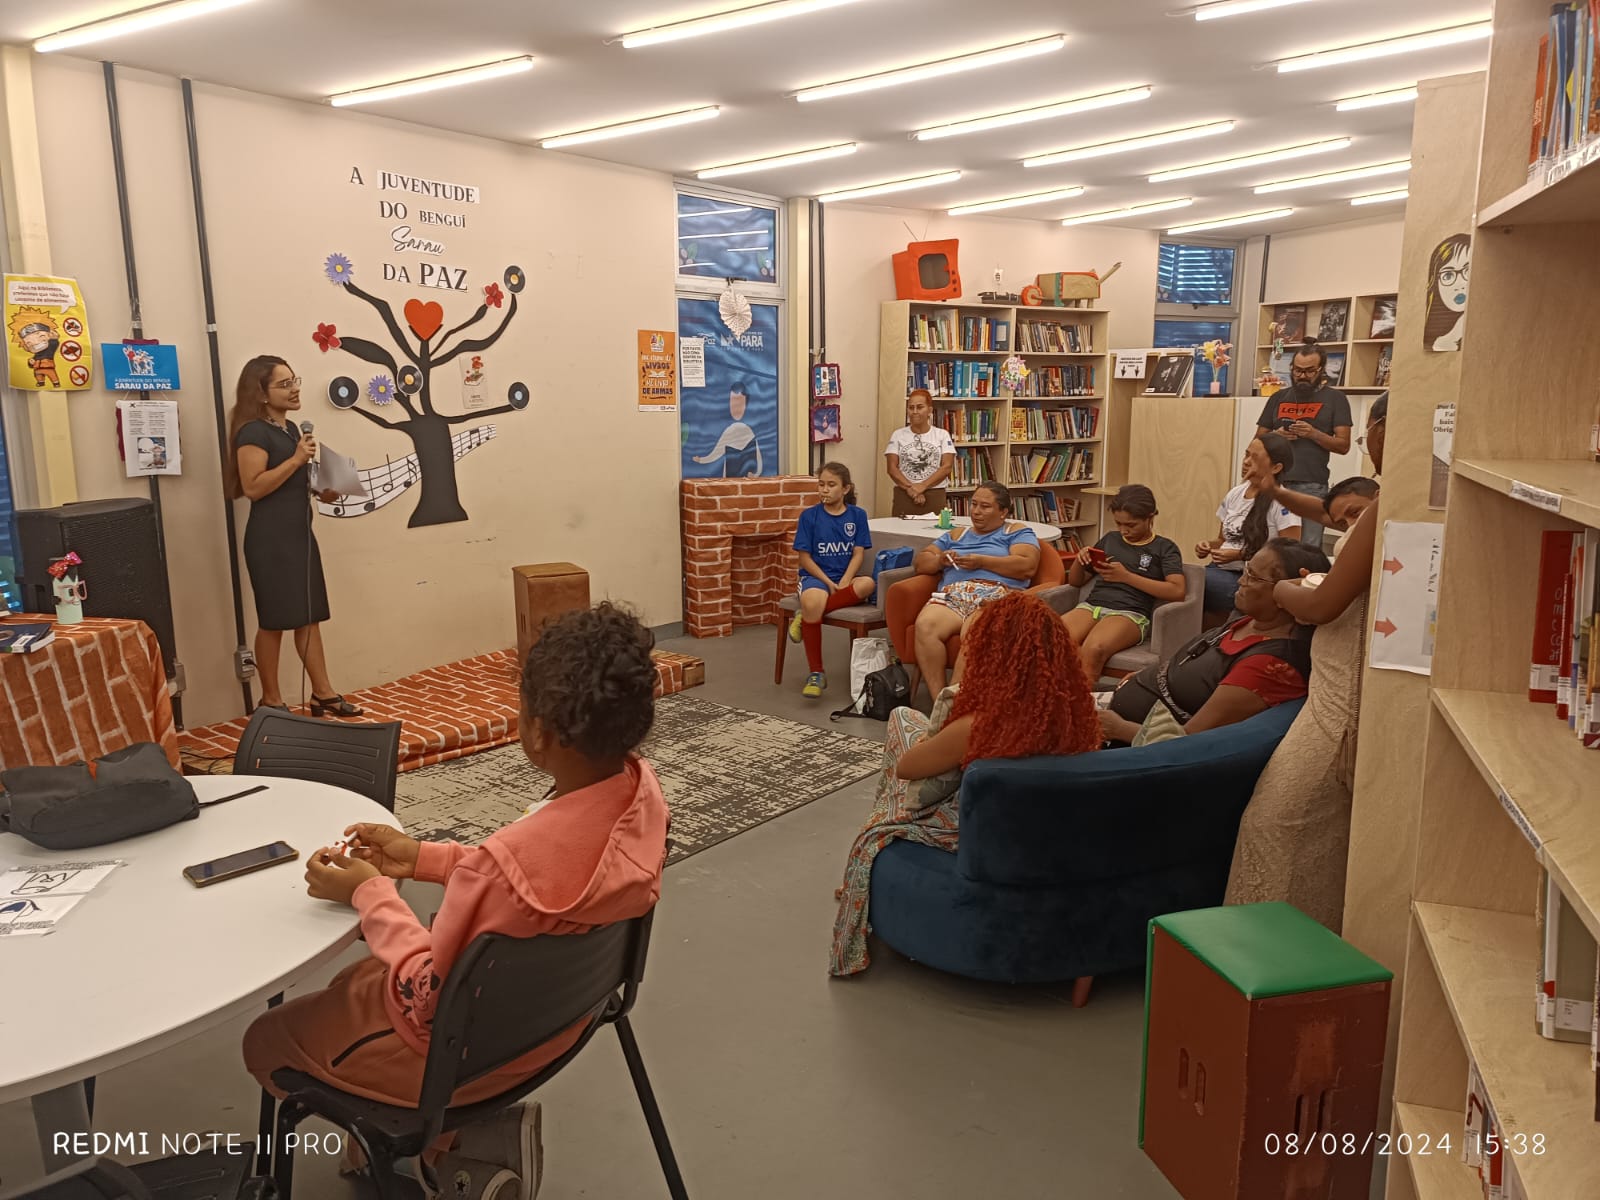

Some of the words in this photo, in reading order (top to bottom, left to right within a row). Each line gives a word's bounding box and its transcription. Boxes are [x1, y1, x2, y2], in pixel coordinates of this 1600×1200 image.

[350, 166, 364, 185] A
[381, 172, 475, 203] JUVENTUDE
[379, 201, 408, 219] DO
[419, 210, 466, 228] BENGUÍ
[391, 226, 444, 254] Sarau
[382, 263, 411, 283] DA
[419, 262, 468, 291] PAZ
[652, 387, 673, 395] ARMAS
